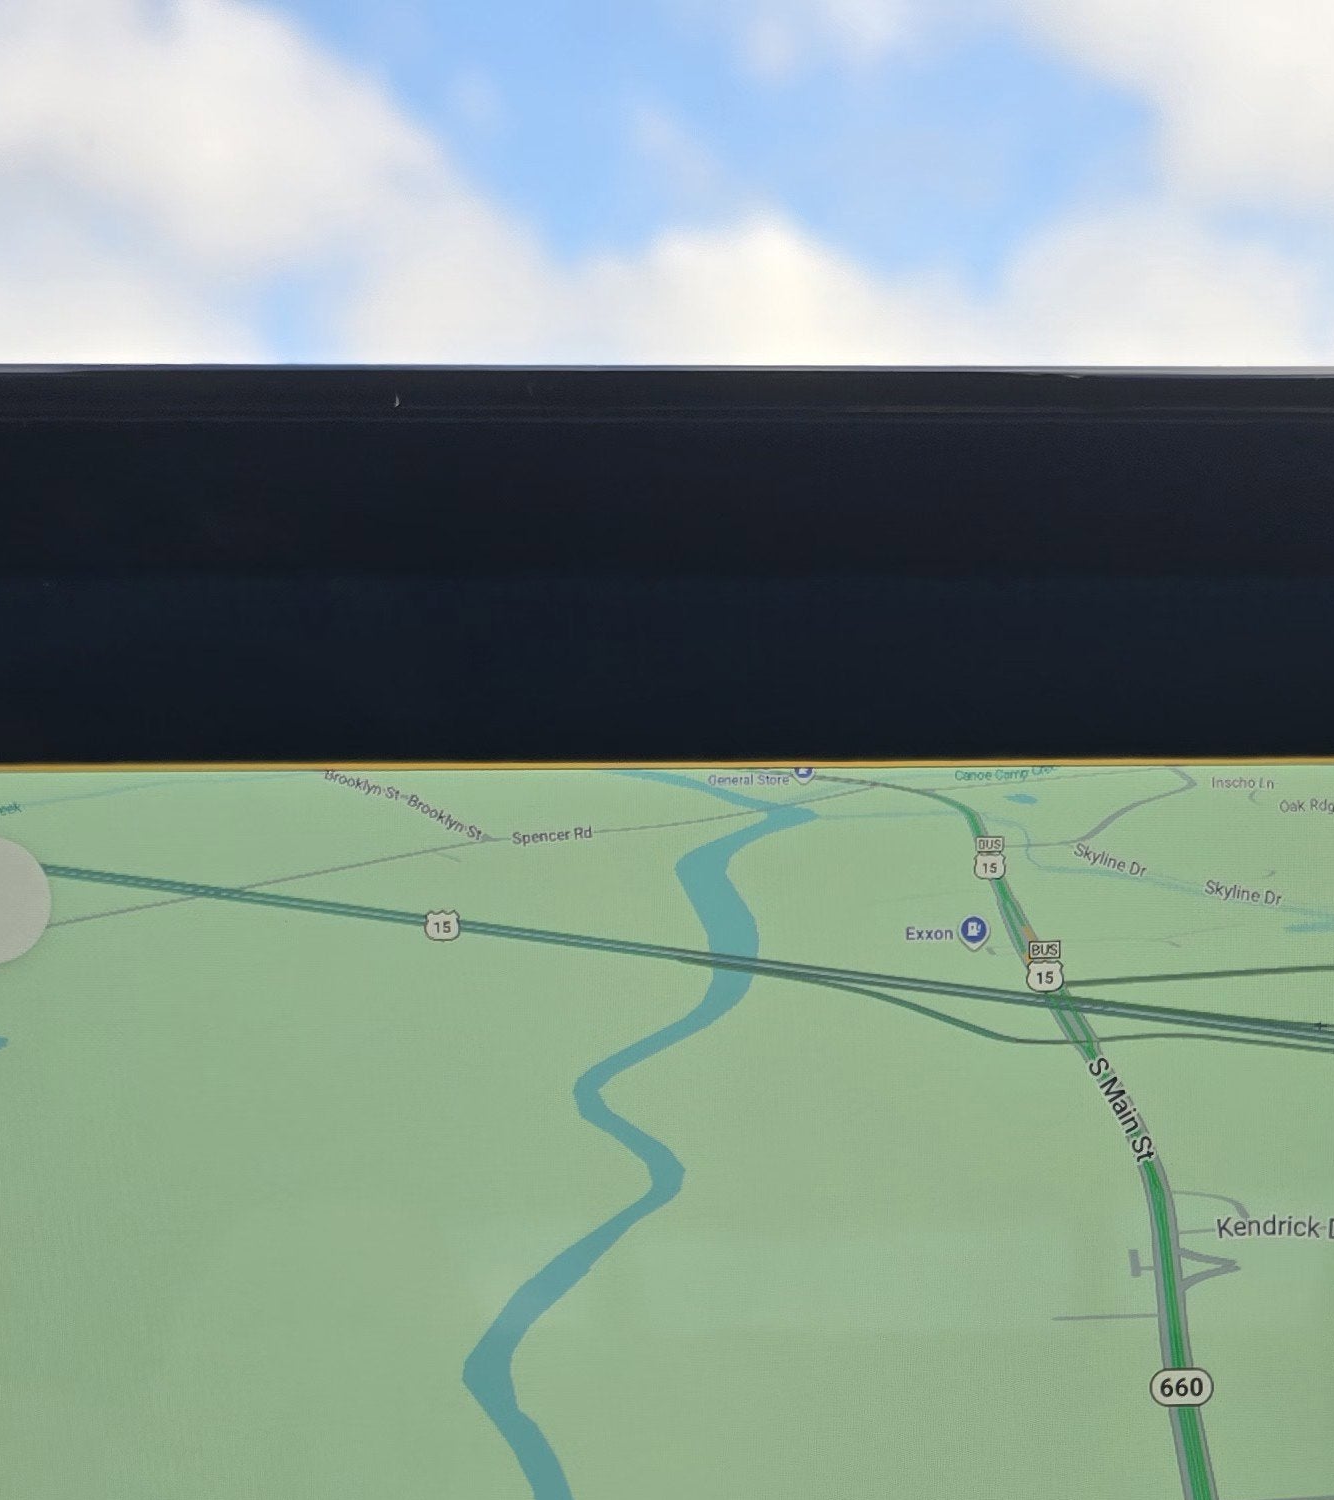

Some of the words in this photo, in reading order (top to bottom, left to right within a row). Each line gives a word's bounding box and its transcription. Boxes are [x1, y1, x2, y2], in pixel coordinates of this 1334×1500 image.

[708, 773, 754, 787] General
[760, 771, 790, 786] Store
[1279, 799, 1306, 814] Oak
[407, 793, 465, 834] Brooklyn
[467, 824, 483, 841] St
[511, 830, 569, 847] Spencer
[573, 826, 594, 842] Rd
[982, 862, 997, 874] 15
[1073, 842, 1127, 873] Skyline
[1129, 861, 1148, 878] Dr
[1204, 879, 1262, 905] Skyline
[1264, 890, 1283, 907] Dr
[433, 921, 451, 935] 15
[905, 927, 954, 942] Exxon
[1031, 944, 1058, 957] BUS
[1037, 971, 1054, 985] 15
[1088, 1056, 1109, 1077] S
[1099, 1075, 1143, 1135] Main
[1129, 1134, 1156, 1163] St
[1216, 1214, 1320, 1240] Kendrick
[1159, 1377, 1205, 1398] 660
